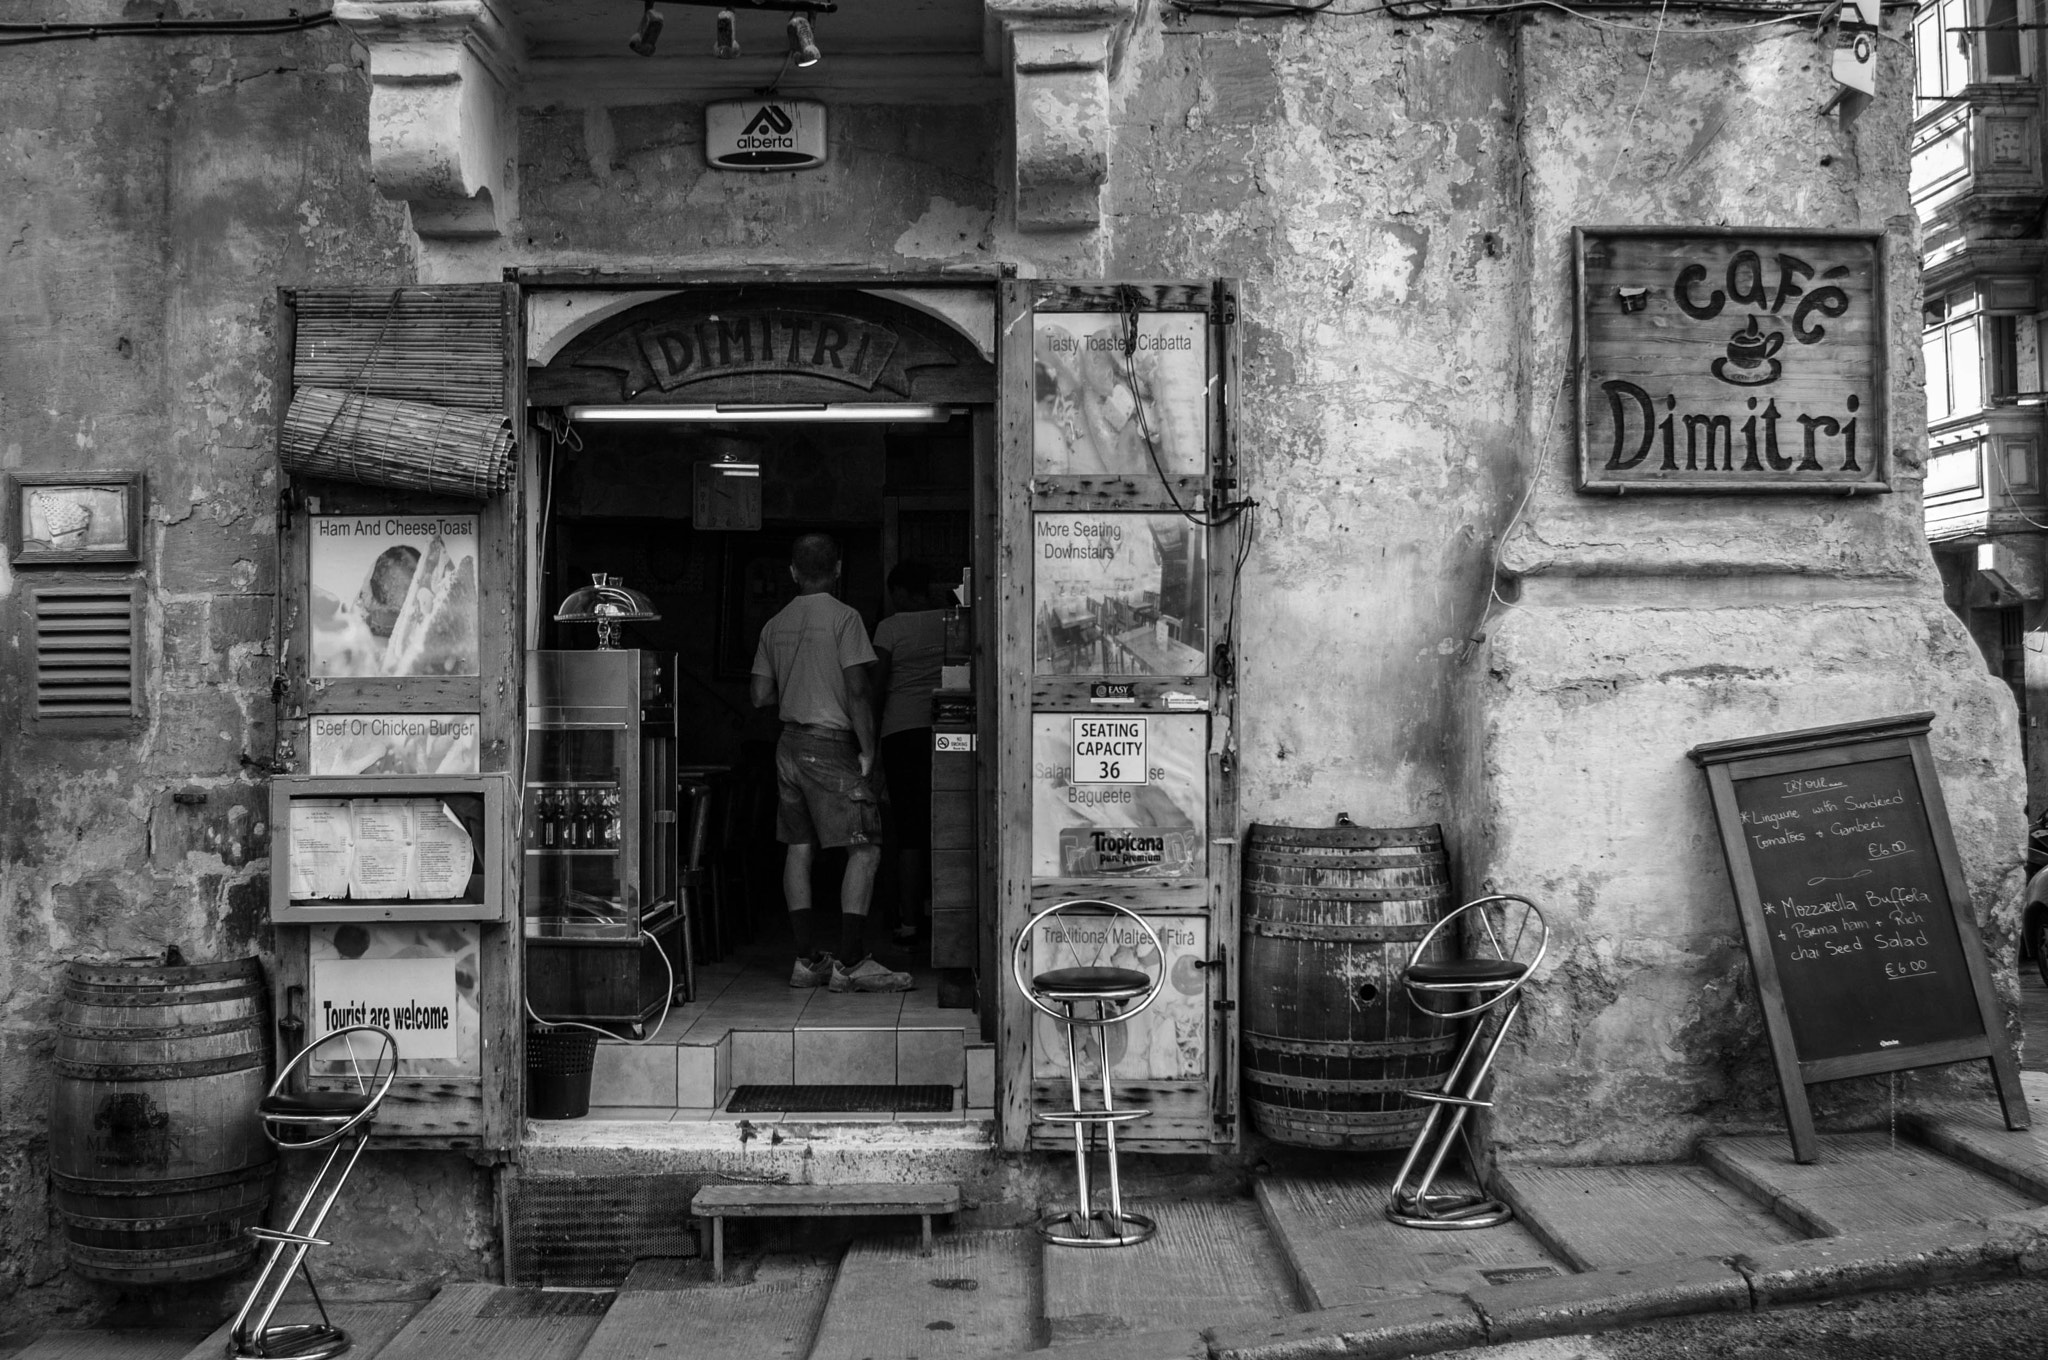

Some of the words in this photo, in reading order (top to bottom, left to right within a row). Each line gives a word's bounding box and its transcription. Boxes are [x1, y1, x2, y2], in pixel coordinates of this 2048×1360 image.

[737, 136, 793, 149] alberta
[656, 316, 871, 376] DIMITRI
[1046, 335, 1079, 354] Tasty
[1083, 335, 1135, 351] Toaste
[1138, 334, 1191, 351] Ciabatta
[1601, 380, 1861, 471] Dimitri
[320, 520, 350, 536] Ham
[354, 520, 381, 536] And
[385, 519, 436, 536] Cheese
[436, 519, 472, 535] Toast
[1037, 521, 1069, 537] More
[1073, 521, 1121, 540] Seating
[1044, 543, 1115, 559] Downstairs
[1109, 686, 1128, 694] EASY
[316, 719, 347, 736] Beef
[351, 719, 367, 736] Or
[371, 718, 425, 736] Chicken
[430, 719, 475, 739] Burger
[1081, 723, 1139, 737] SEATING
[1076, 742, 1143, 756] CAPACITY
[1099, 761, 1120, 778] 36
[1784, 779, 1802, 793] TRY
[1752, 809, 1800, 830] Linguine
[1812, 800, 1838, 815] with
[1090, 831, 1164, 854] Tropicana
[1752, 828, 1806, 850] Tomatoes
[1842, 918, 1870, 931] ham
[1042, 927, 1108, 944] Traditional
[1825, 935, 1863, 955] Seed
[1874, 930, 1929, 949] Salad
[324, 1000, 366, 1031] Tourist
[370, 1005, 390, 1030] are
[393, 999, 449, 1030] welcome
